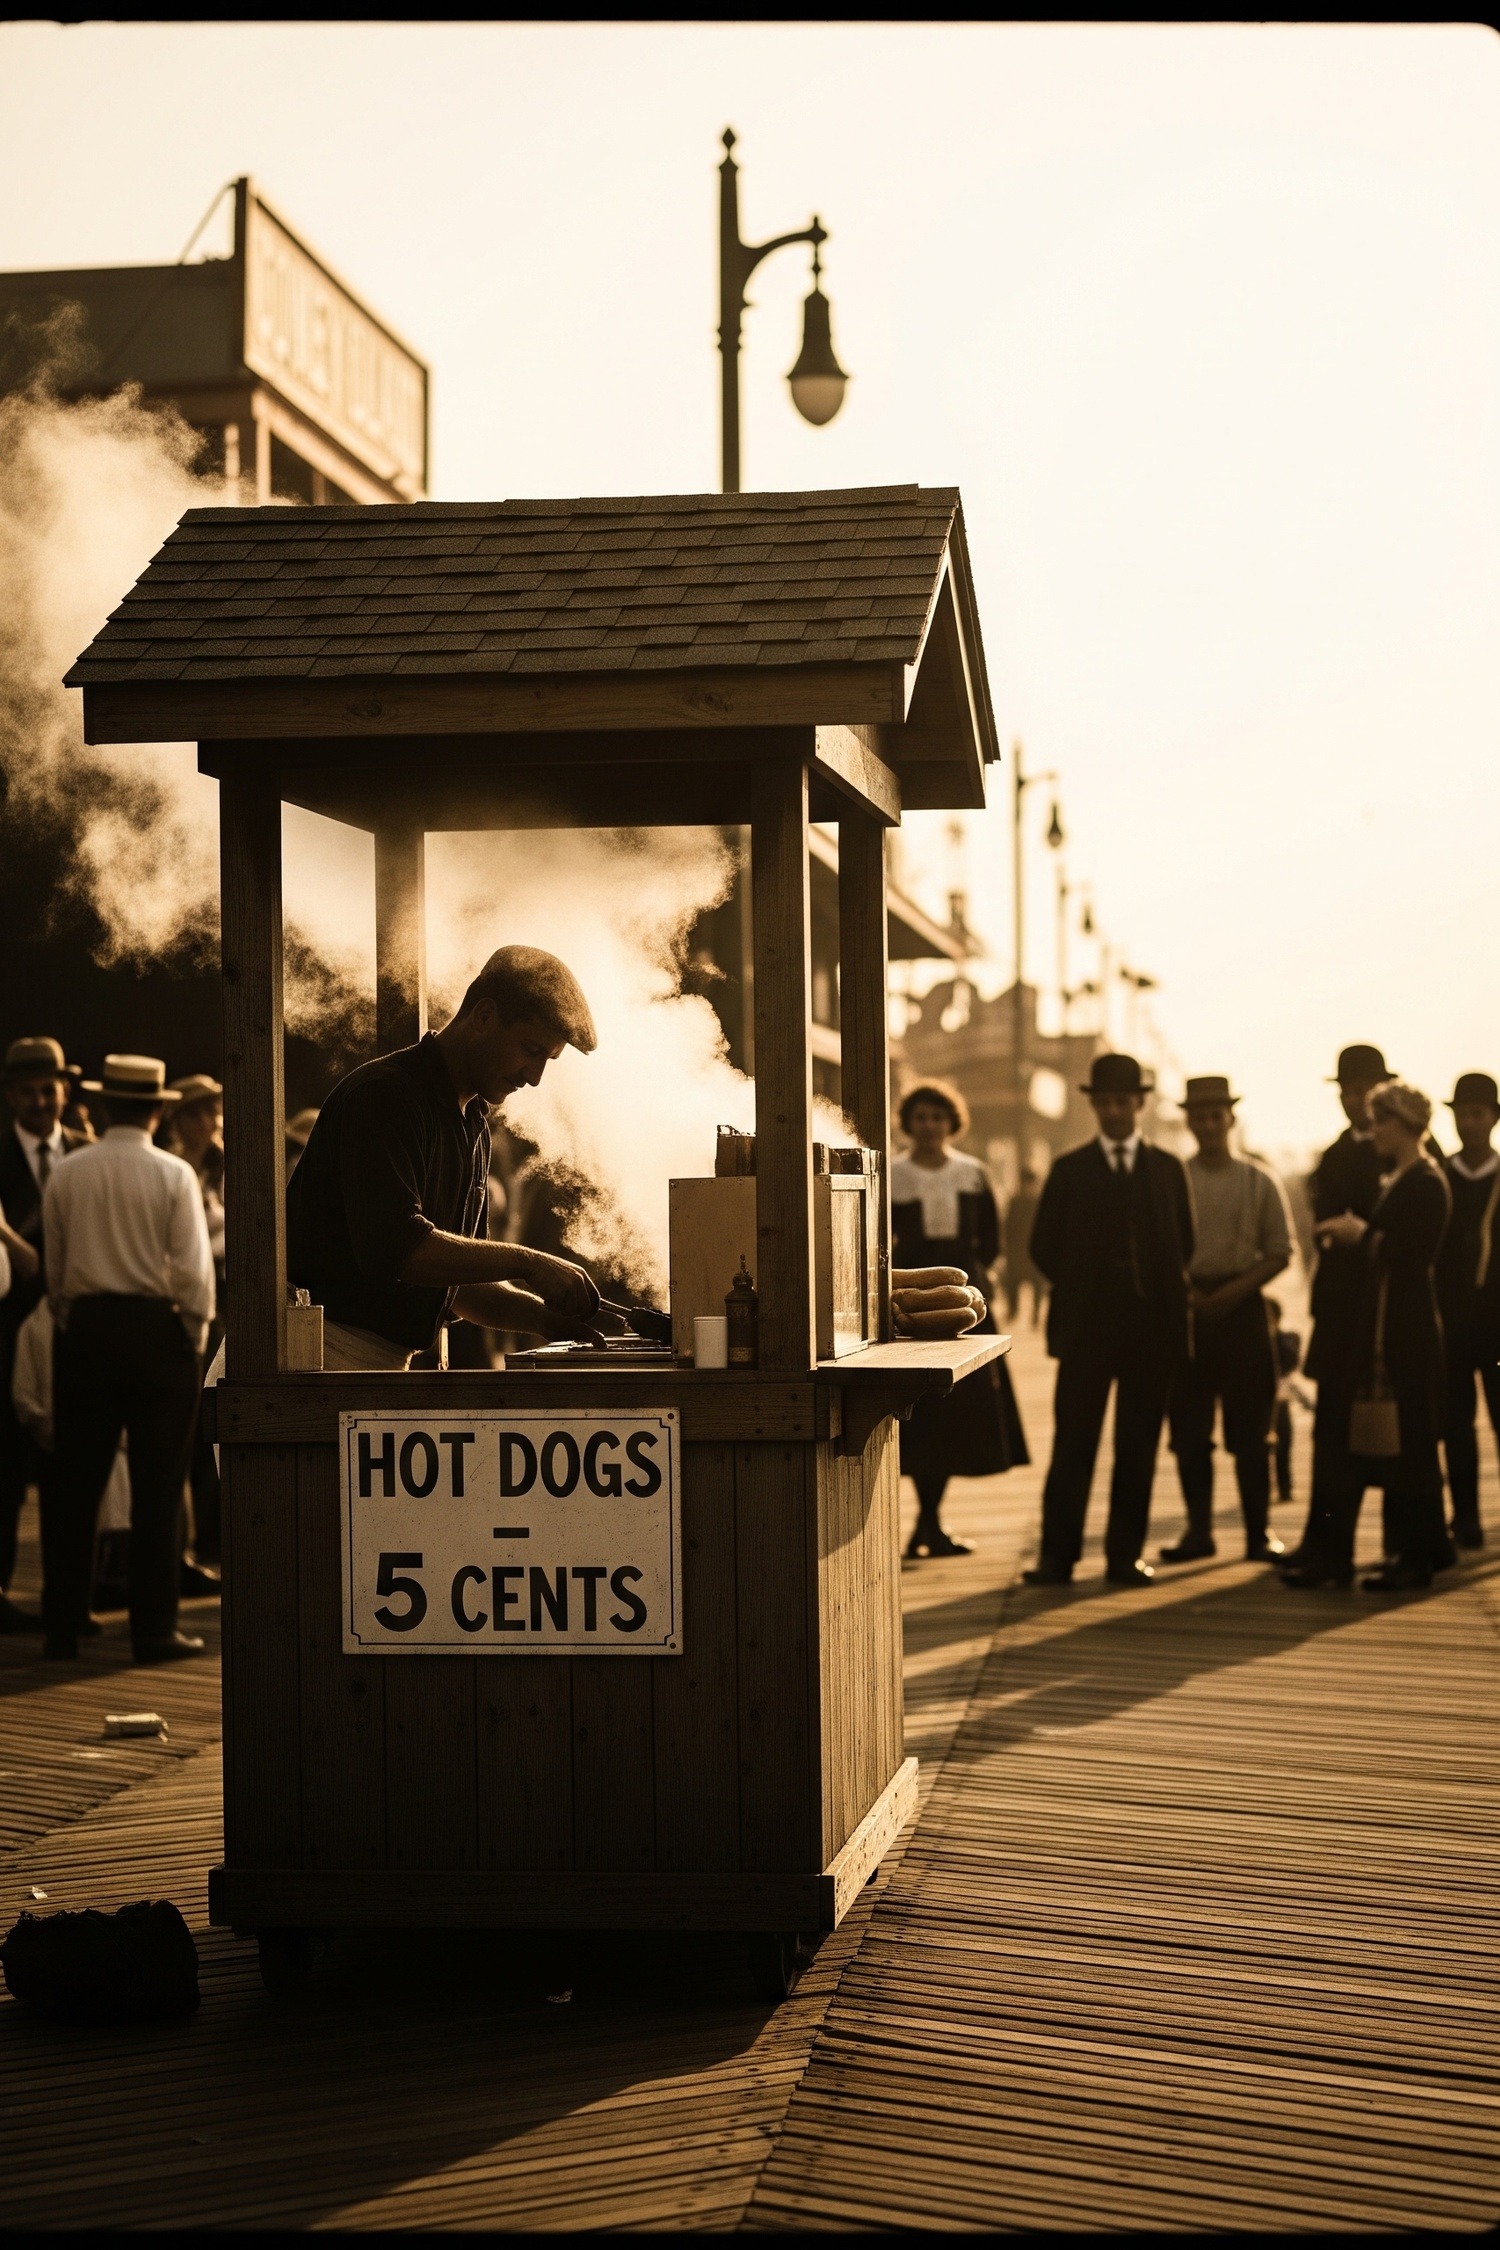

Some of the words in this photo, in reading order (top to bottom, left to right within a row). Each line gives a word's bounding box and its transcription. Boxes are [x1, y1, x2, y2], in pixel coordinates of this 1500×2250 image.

[357, 1431, 476, 1498] HOT
[499, 1430, 662, 1498] DOGS
[373, 1552, 428, 1633] 5
[450, 1564, 648, 1633] CENTS
